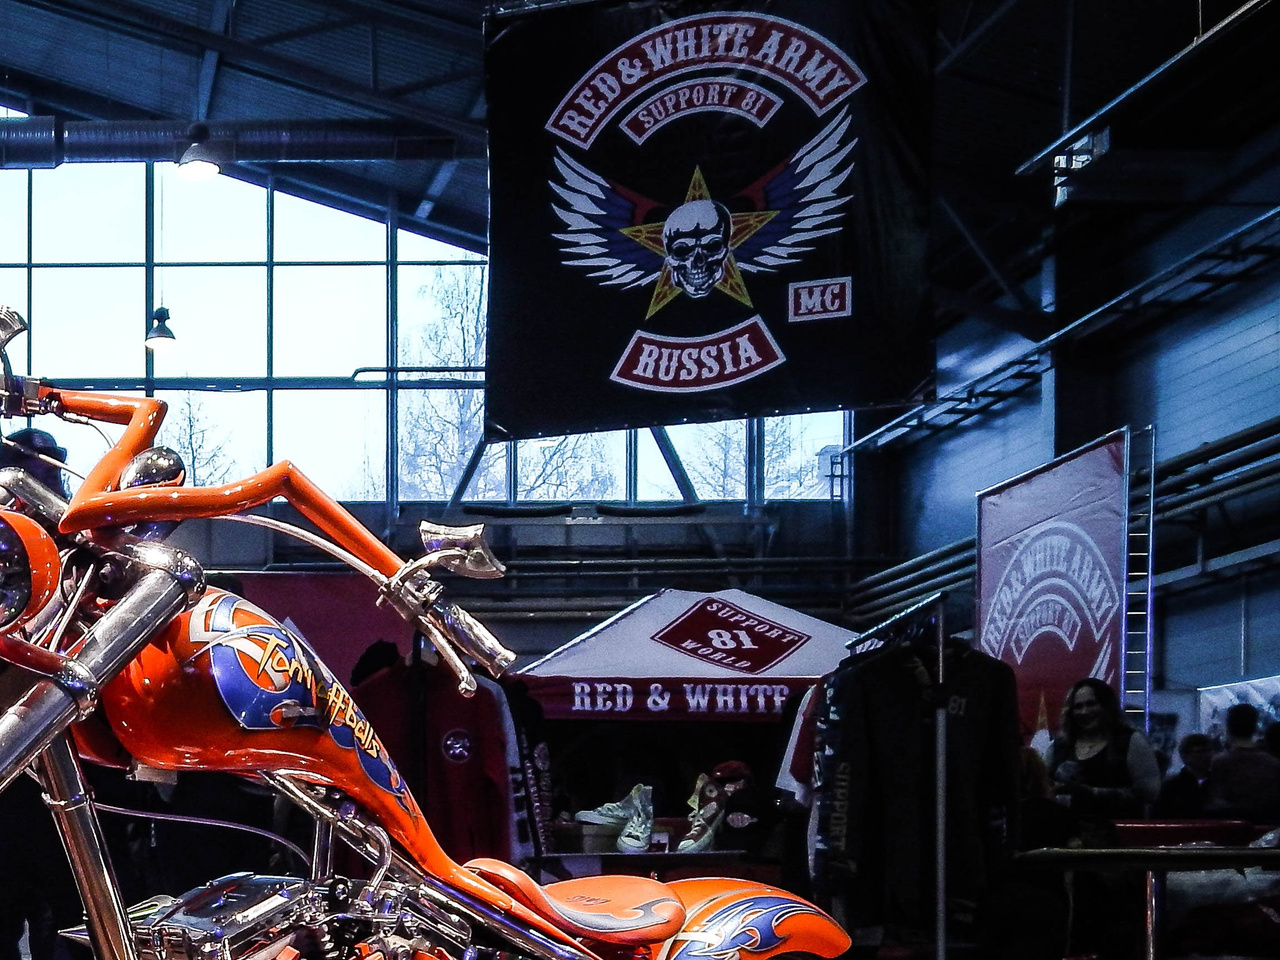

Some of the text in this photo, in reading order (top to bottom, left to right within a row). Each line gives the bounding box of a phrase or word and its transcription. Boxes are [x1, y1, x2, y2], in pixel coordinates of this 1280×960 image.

[559, 23, 852, 139] RED & WHITE ARMY
[637, 84, 769, 129] SUPPORT 81
[798, 284, 840, 314] MC
[632, 333, 763, 381] RUSSIA
[1020, 535, 1071, 581] WHITE
[1069, 544, 1113, 623] ARMY
[706, 601, 799, 644] SUPPORT
[707, 629, 759, 649] 81
[1017, 602, 1062, 648] SUPPORT
[679, 638, 752, 669] WORLD
[571, 682, 634, 712] RED
[646, 683, 671, 711] &
